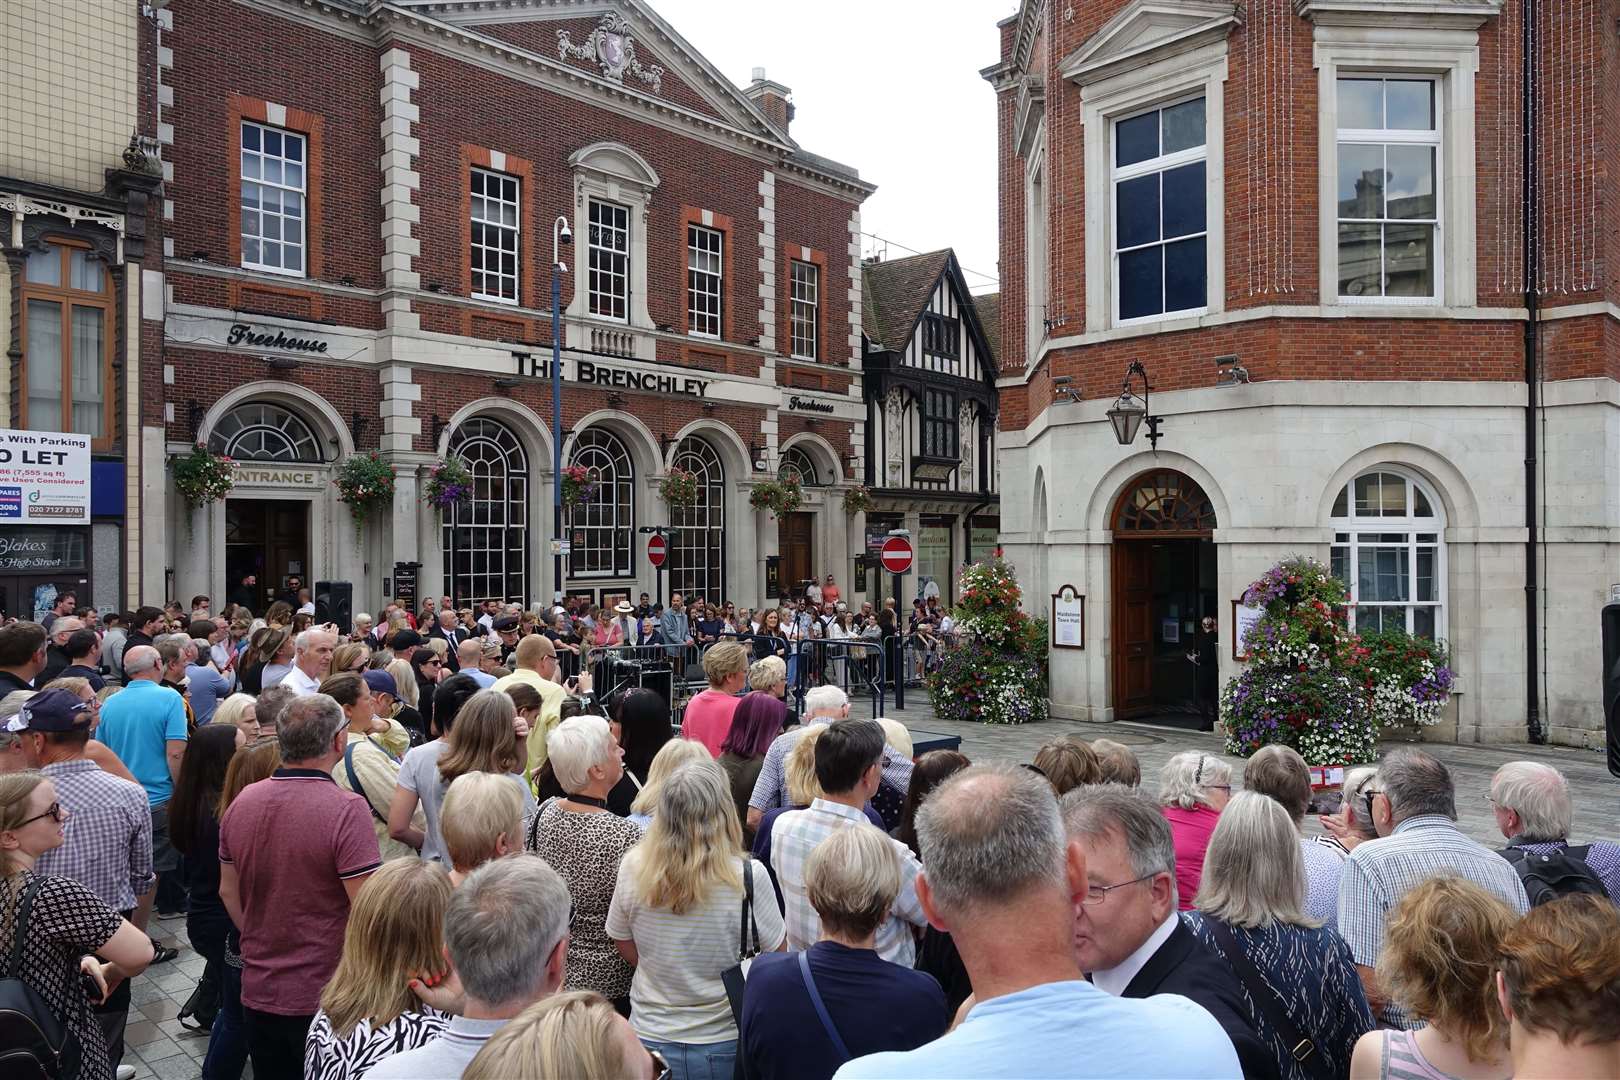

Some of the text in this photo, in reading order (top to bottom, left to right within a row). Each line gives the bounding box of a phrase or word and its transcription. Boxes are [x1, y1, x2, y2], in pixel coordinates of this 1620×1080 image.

[227, 324, 327, 352] Freehouse
[511, 351, 708, 397] THE BRENCHLEY
[789, 396, 834, 413] Freehouse
[8, 435, 36, 444] With
[40, 437, 86, 448] Parking
[22, 450, 68, 466] LET
[37, 477, 85, 485] Considered
[0, 537, 47, 555] Blakes
[5, 557, 32, 569] High
[32, 557, 62, 567] Street
